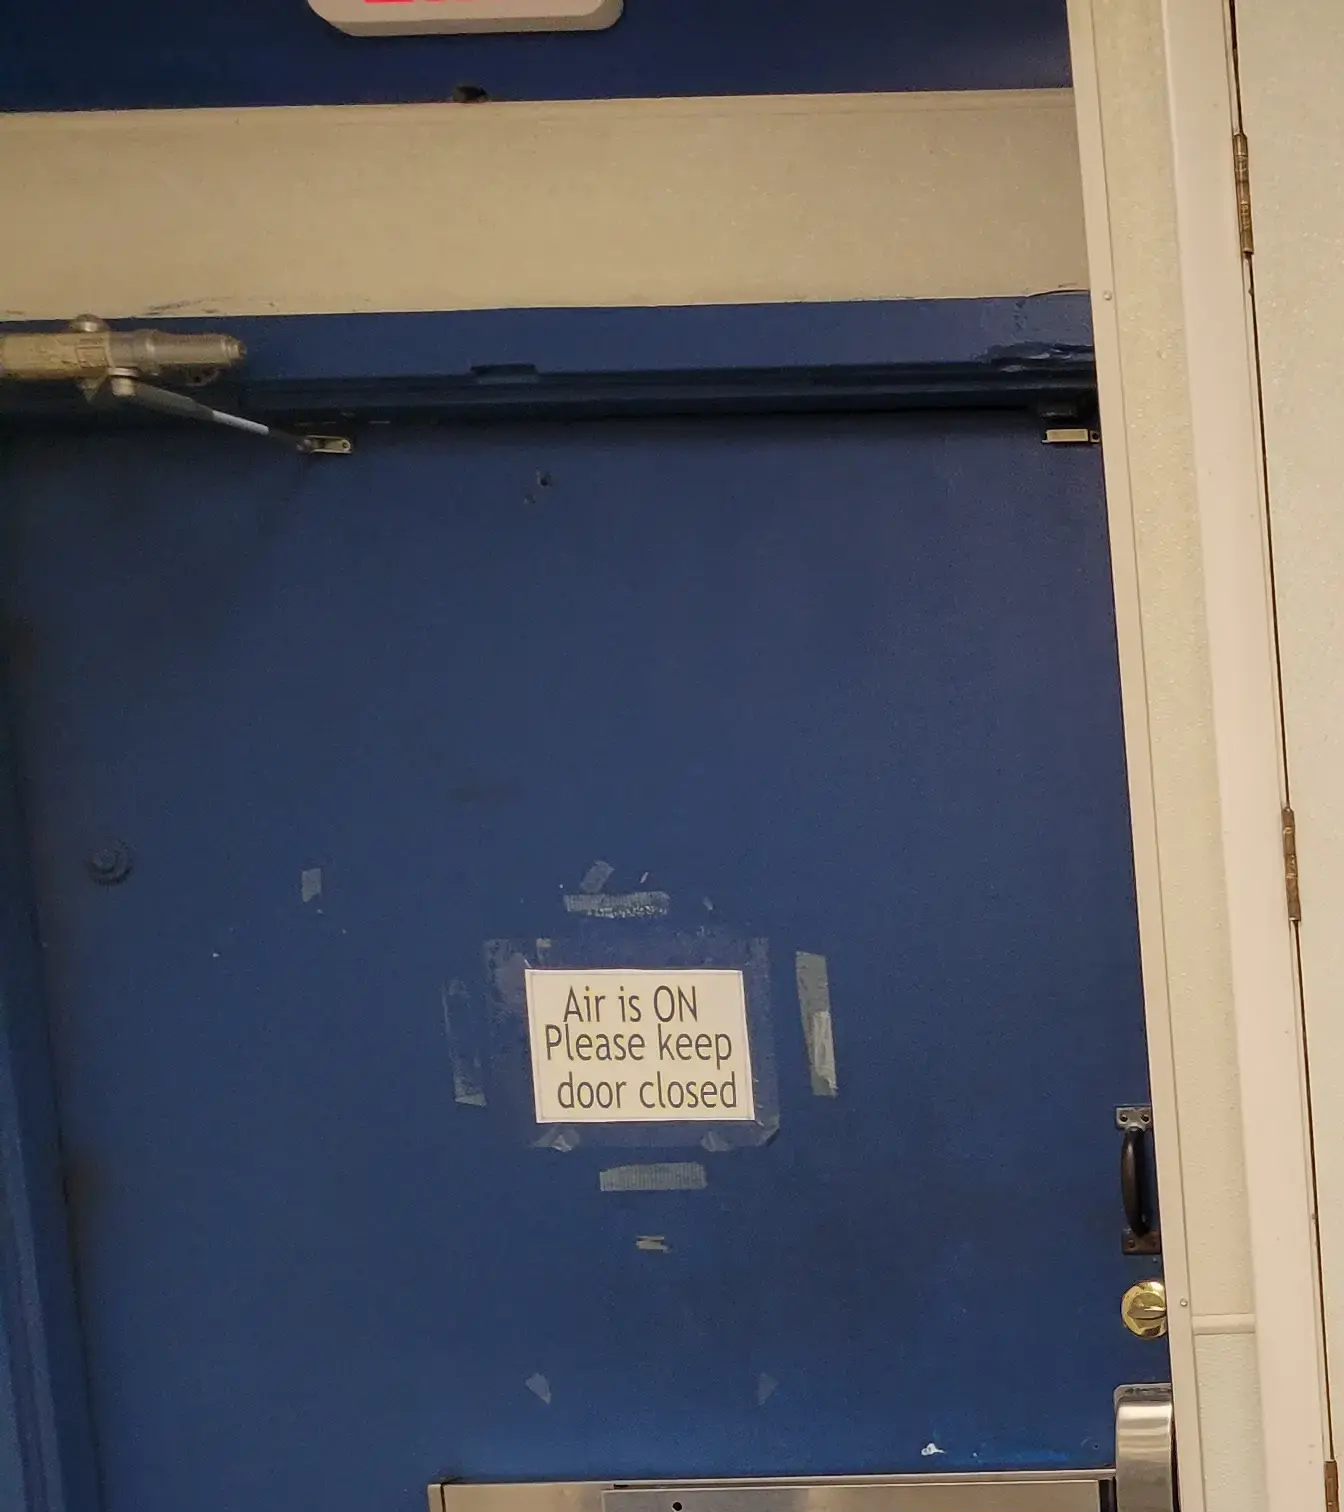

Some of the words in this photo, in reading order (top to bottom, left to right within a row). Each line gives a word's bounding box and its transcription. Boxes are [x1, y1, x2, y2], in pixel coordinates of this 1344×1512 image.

[563, 985, 606, 1023] Air
[618, 985, 642, 1023] is
[653, 985, 698, 1023] ON
[545, 1023, 645, 1061] Please
[657, 1023, 732, 1070] keep
[557, 1071, 627, 1108] door
[639, 1070, 737, 1108] closed
